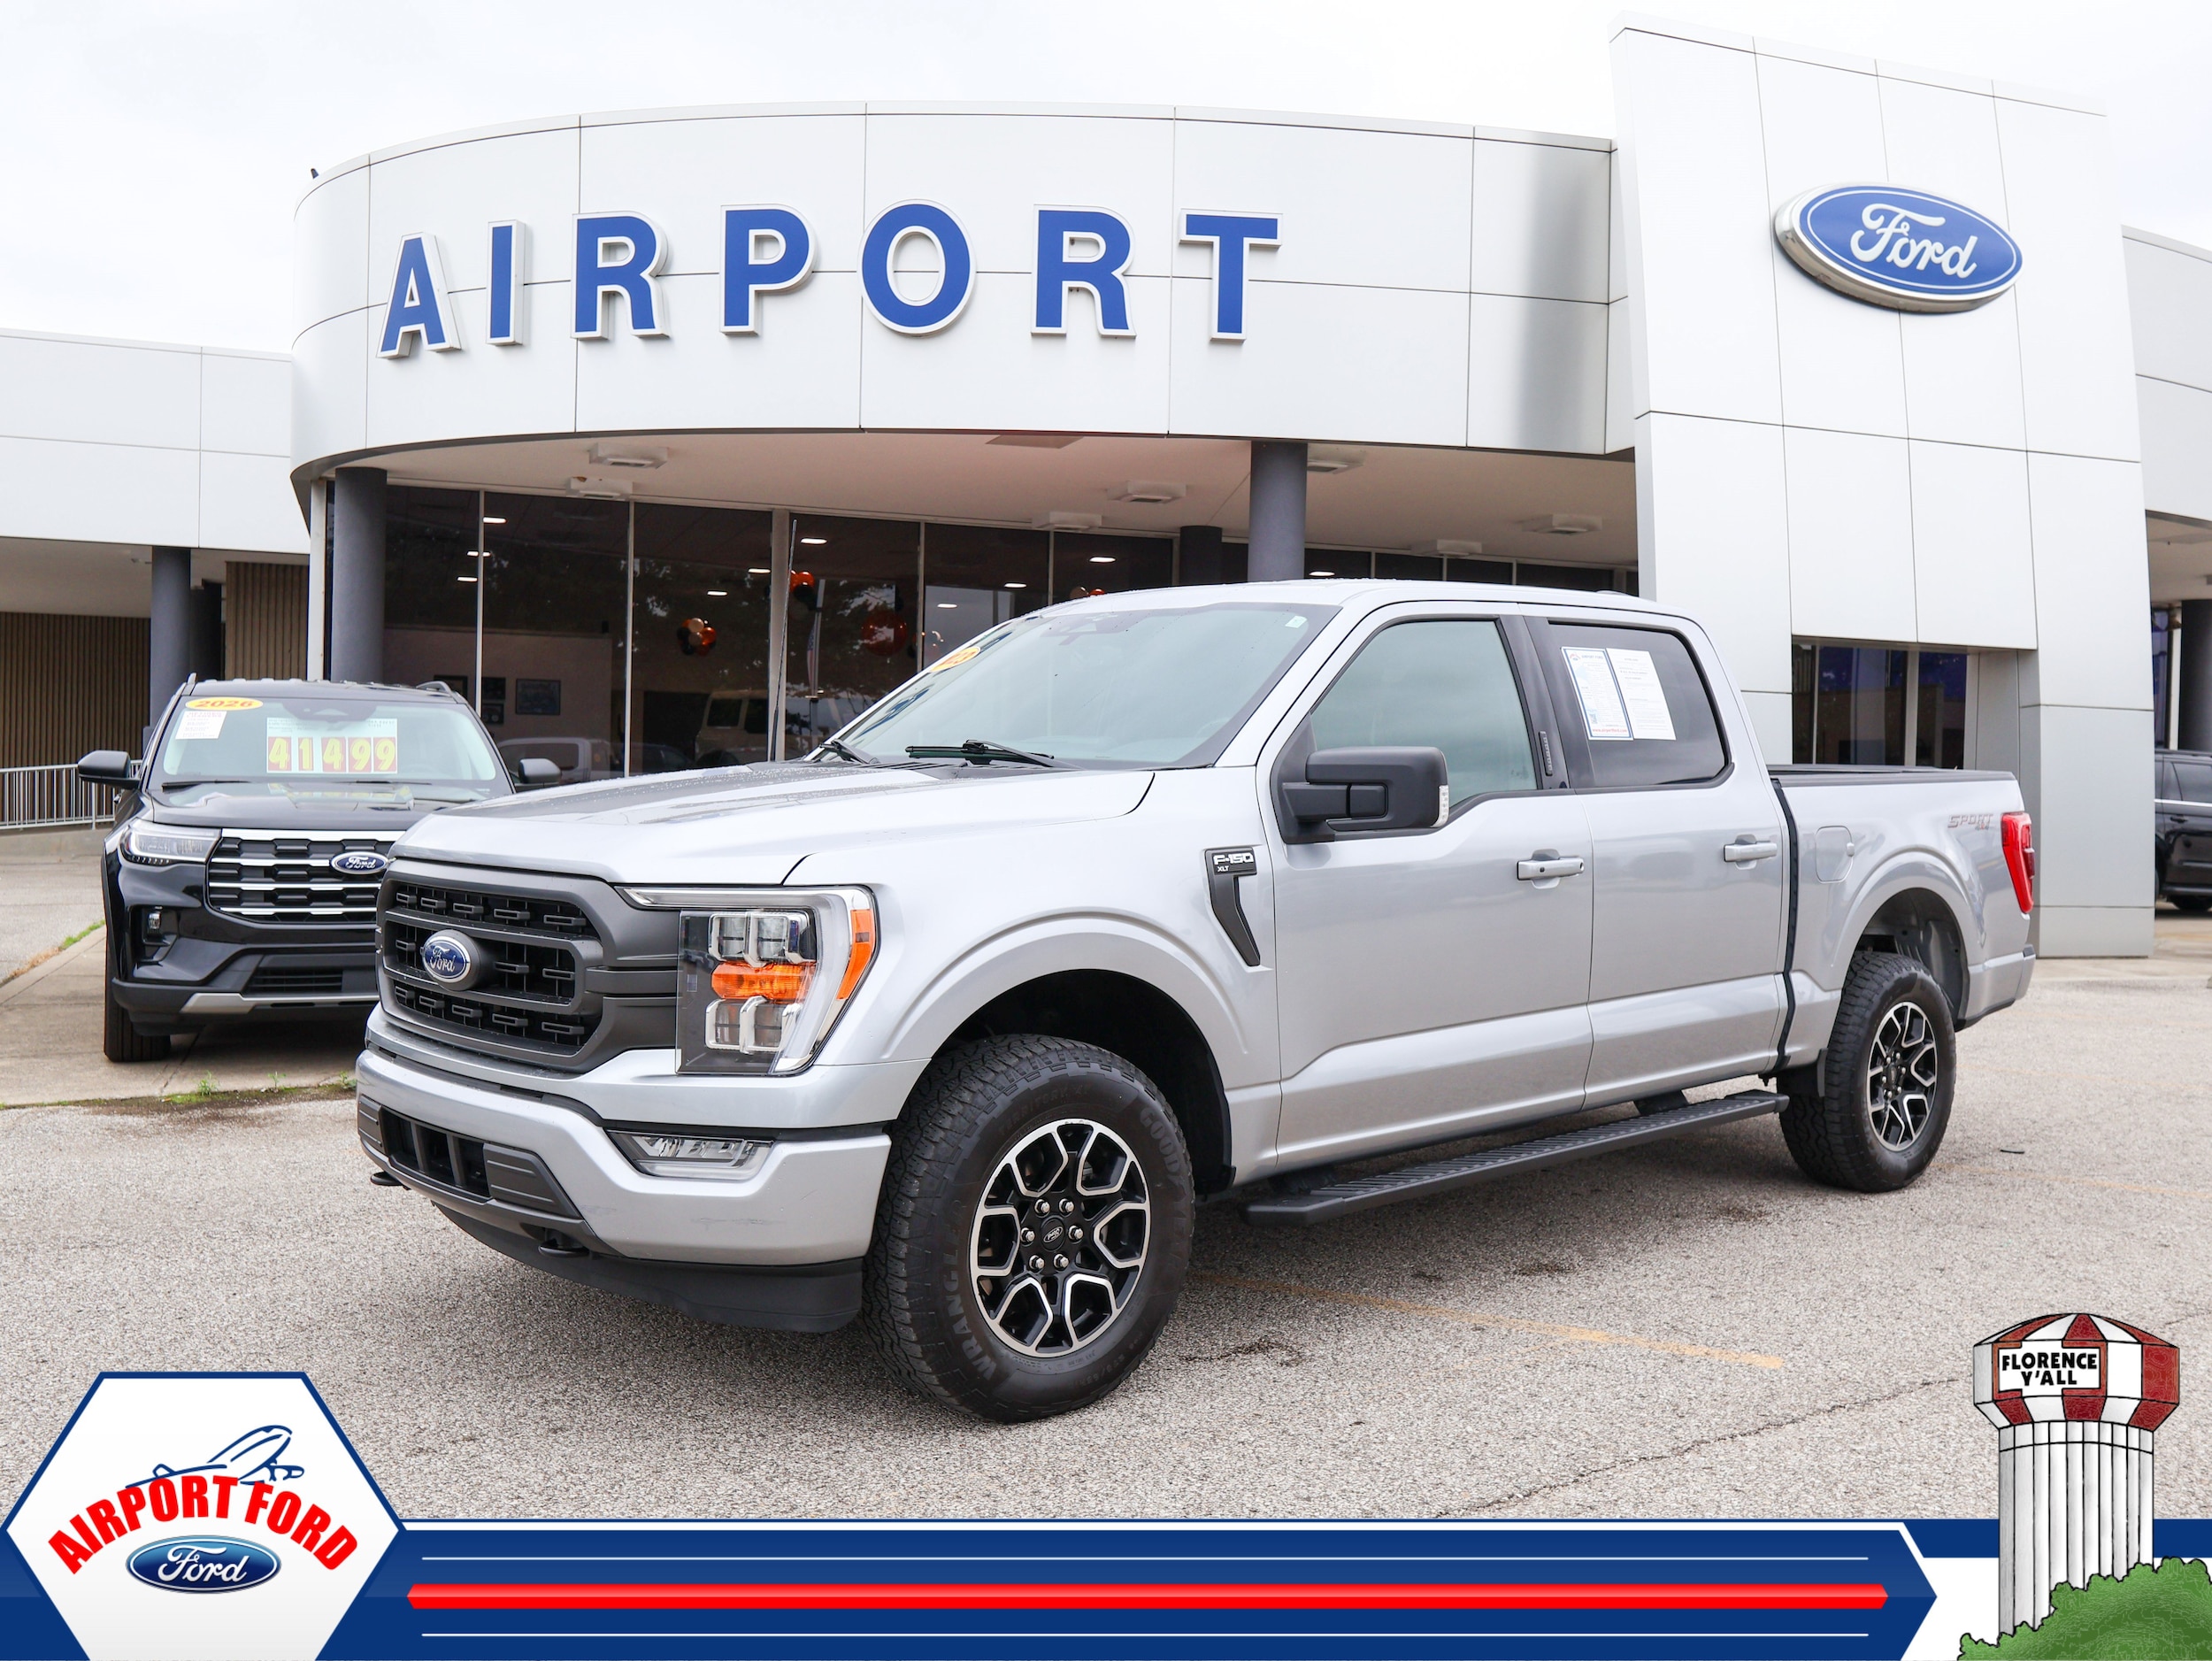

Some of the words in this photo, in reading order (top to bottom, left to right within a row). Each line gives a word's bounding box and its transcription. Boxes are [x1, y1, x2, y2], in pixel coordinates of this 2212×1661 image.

[1850, 203, 1978, 279] Ford
[376, 199, 1283, 358] AIRPORT
[194, 699, 256, 708] 2026
[268, 737, 396, 772] 41499
[1947, 813, 1994, 828] SPORT
[345, 856, 376, 870] Ford
[1213, 852, 1255, 865] F-150
[429, 946, 457, 973] Ford
